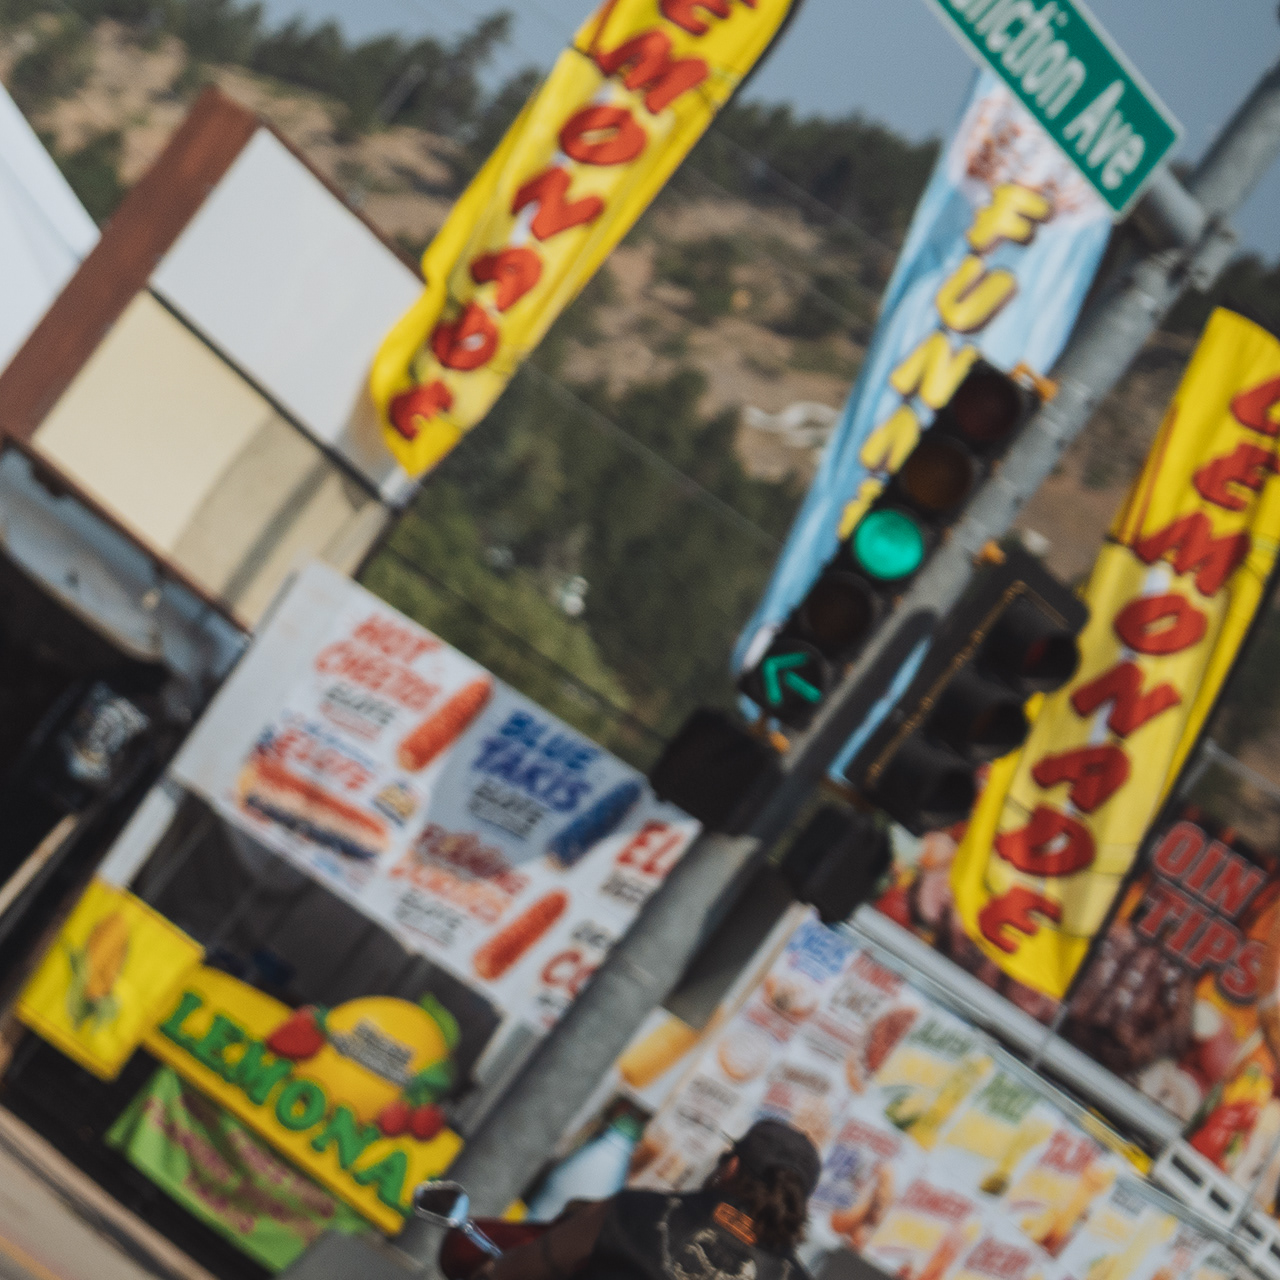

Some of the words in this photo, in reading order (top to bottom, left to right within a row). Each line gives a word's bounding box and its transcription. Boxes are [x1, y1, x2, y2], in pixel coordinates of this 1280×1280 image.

[1062, 78, 1146, 191] Ave
[352, 614, 443, 666] HOT
[472, 734, 593, 813] TAKIS
[498, 708, 598, 771] BLUE
[1138, 881, 1268, 998] TIPS
